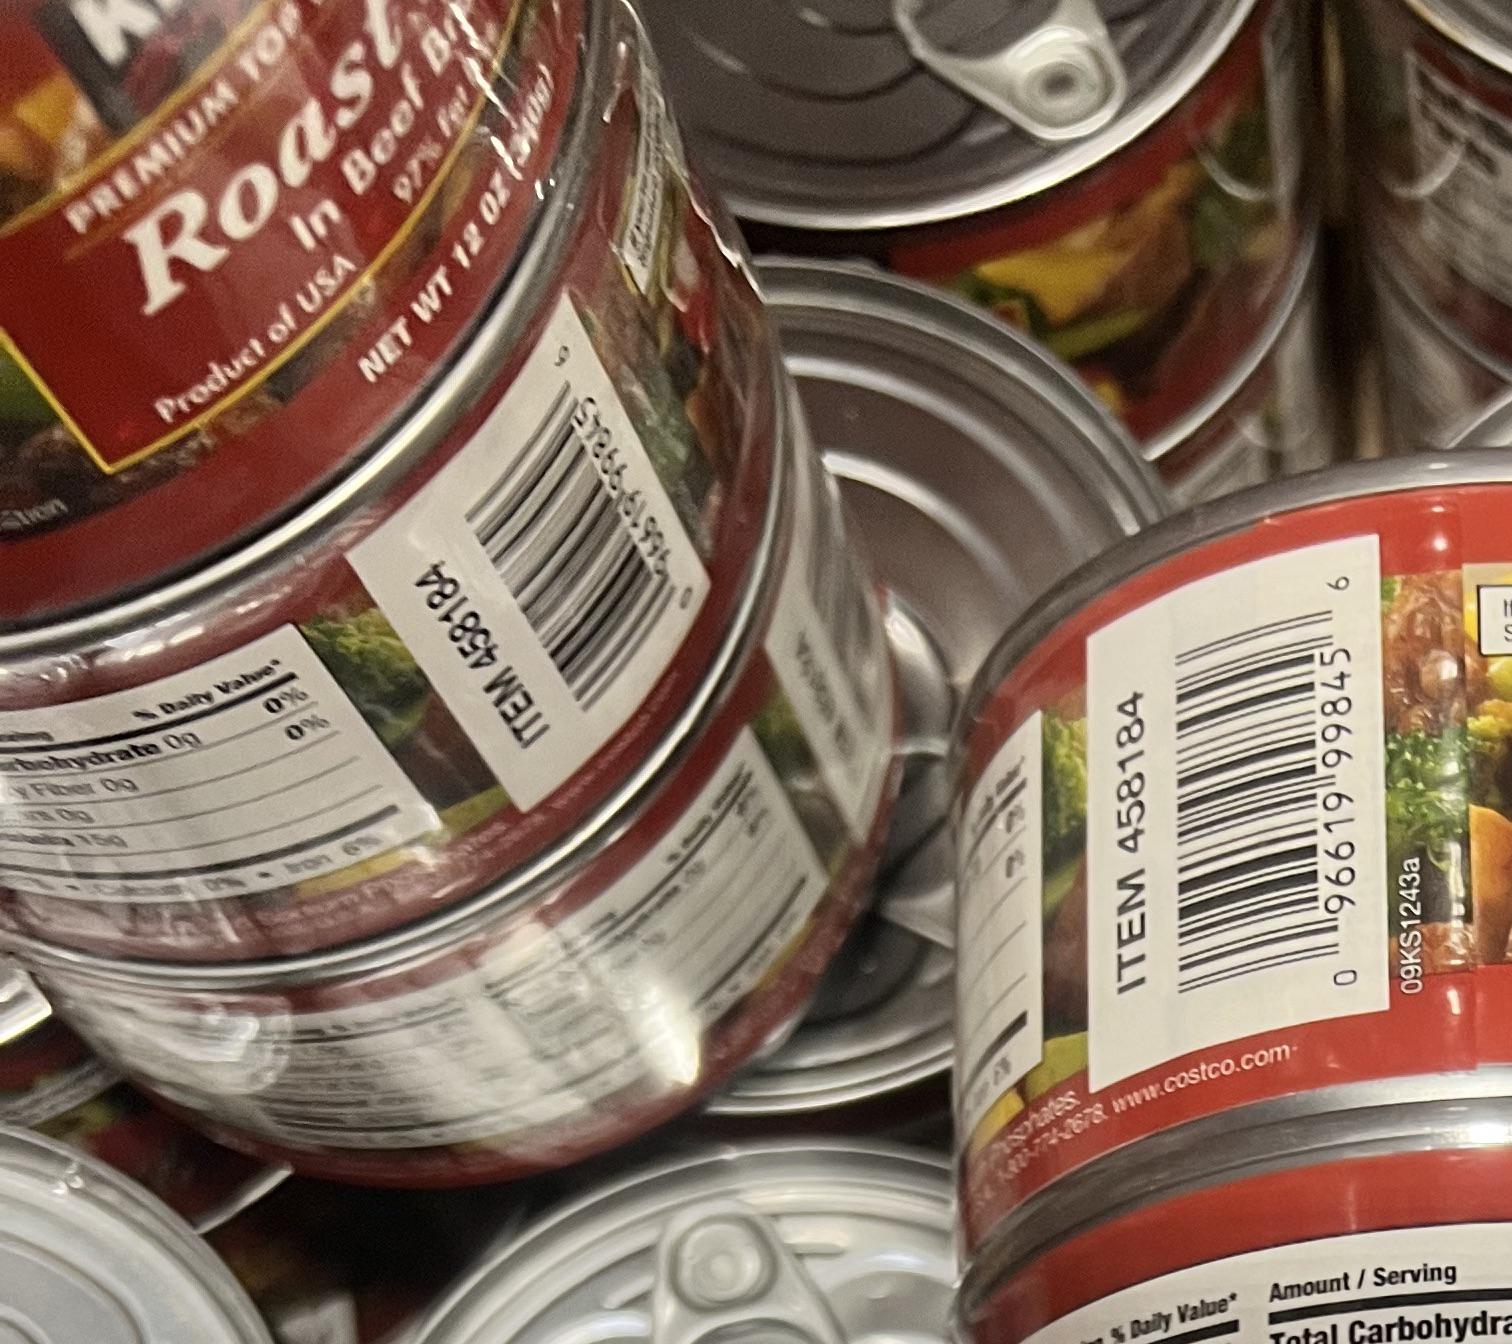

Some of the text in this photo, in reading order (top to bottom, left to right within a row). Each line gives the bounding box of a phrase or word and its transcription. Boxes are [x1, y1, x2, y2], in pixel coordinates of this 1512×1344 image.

[64, 78, 238, 234] PREMIUM
[122, 0, 402, 317] Roast
[289, 198, 343, 251] In
[153, 254, 357, 424] Product of USA
[357, 315, 413, 384] NET
[410, 264, 453, 325] WT
[452, 220, 485, 270] 12
[262, 686, 310, 715] 0%
[284, 712, 330, 742] 0%
[415, 560, 551, 750] ITEM 458184
[1115, 689, 1146, 996] ITEM 458184
[1320, 576, 1358, 987] 0 96619 99845 6
[1400, 856, 1422, 995] 09KS1243a
[1111, 1043, 1291, 1115] www.costco.com
[1130, 1310, 1173, 1340] Daily
[1268, 1271, 1351, 1303] Amount
[1372, 1263, 1458, 1288] Serving
